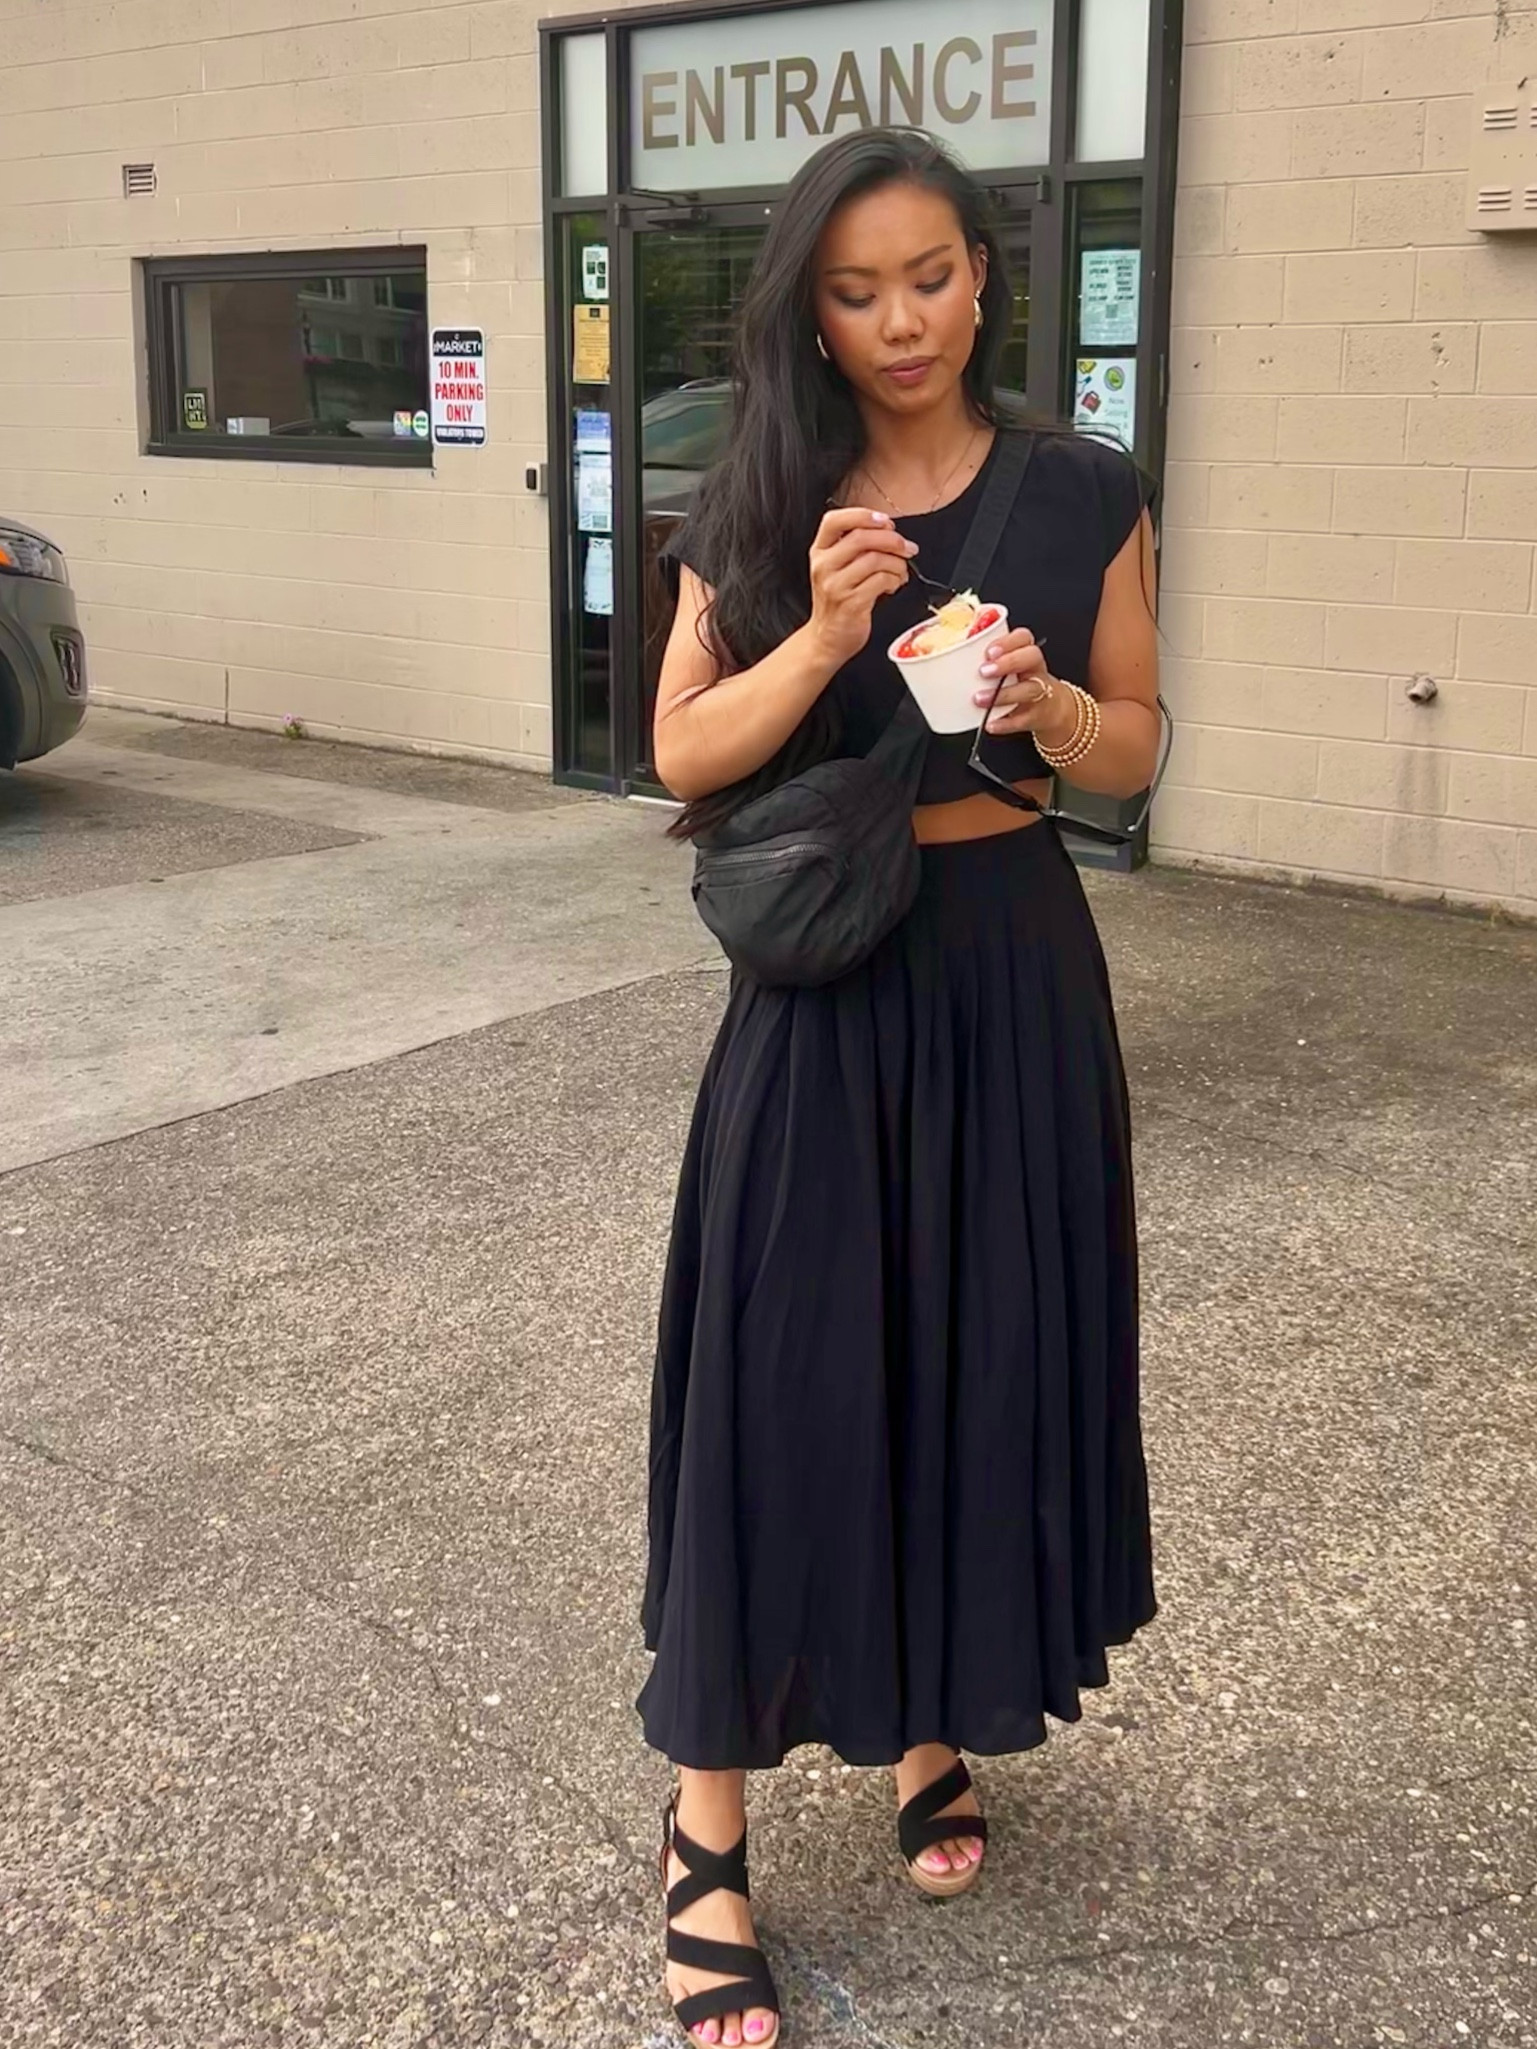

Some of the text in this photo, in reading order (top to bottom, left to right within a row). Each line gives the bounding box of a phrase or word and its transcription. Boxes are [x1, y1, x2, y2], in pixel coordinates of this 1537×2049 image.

[642, 29, 1038, 150] ENTRANCE
[436, 341, 479, 353] MARKET
[438, 361, 479, 379] 10 MIN.
[435, 383, 484, 401] PARKING
[446, 404, 473, 422] ONLY
